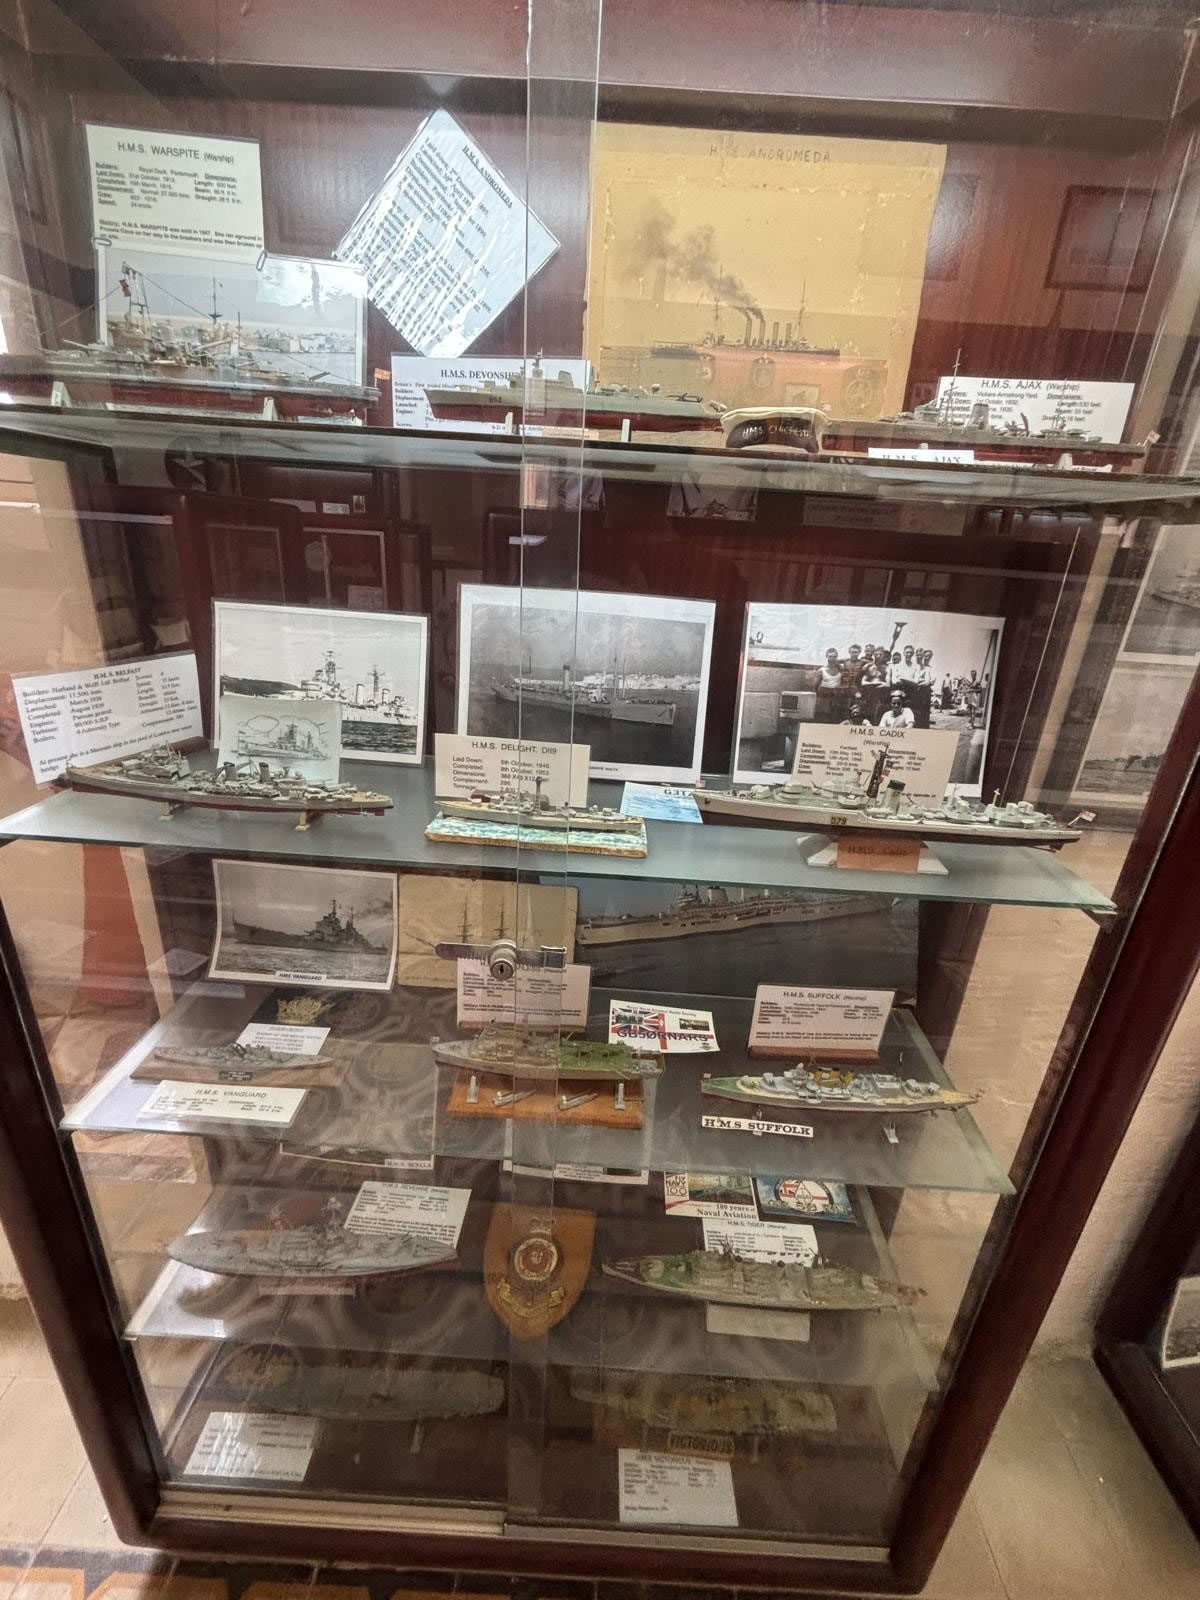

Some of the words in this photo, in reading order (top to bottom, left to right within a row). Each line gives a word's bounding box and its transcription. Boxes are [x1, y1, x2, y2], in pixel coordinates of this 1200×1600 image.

[118, 142, 146, 154] H.M.S.
[151, 145, 200, 160] WARSPITE
[204, 152, 234, 164] (Warship)
[478, 167, 515, 209] ANDROMEDA
[440, 369, 467, 380] H.M.S.
[982, 380, 1011, 393] H.M.S.
[1016, 381, 1042, 393] AJAX
[115, 667, 142, 678] BELFAST
[850, 728, 876, 738] H.M.S.
[880, 730, 905, 739] CADIX
[472, 741, 497, 752] H.M.S.
[452, 756, 466, 764] Laid
[783, 991, 806, 999] H.M.S.
[224, 1090, 267, 1099] VANGUARD
[748, 1122, 811, 1136] SUFFOLK
[697, 1209, 721, 1217] Naval
[722, 1211, 758, 1219] Aviation
